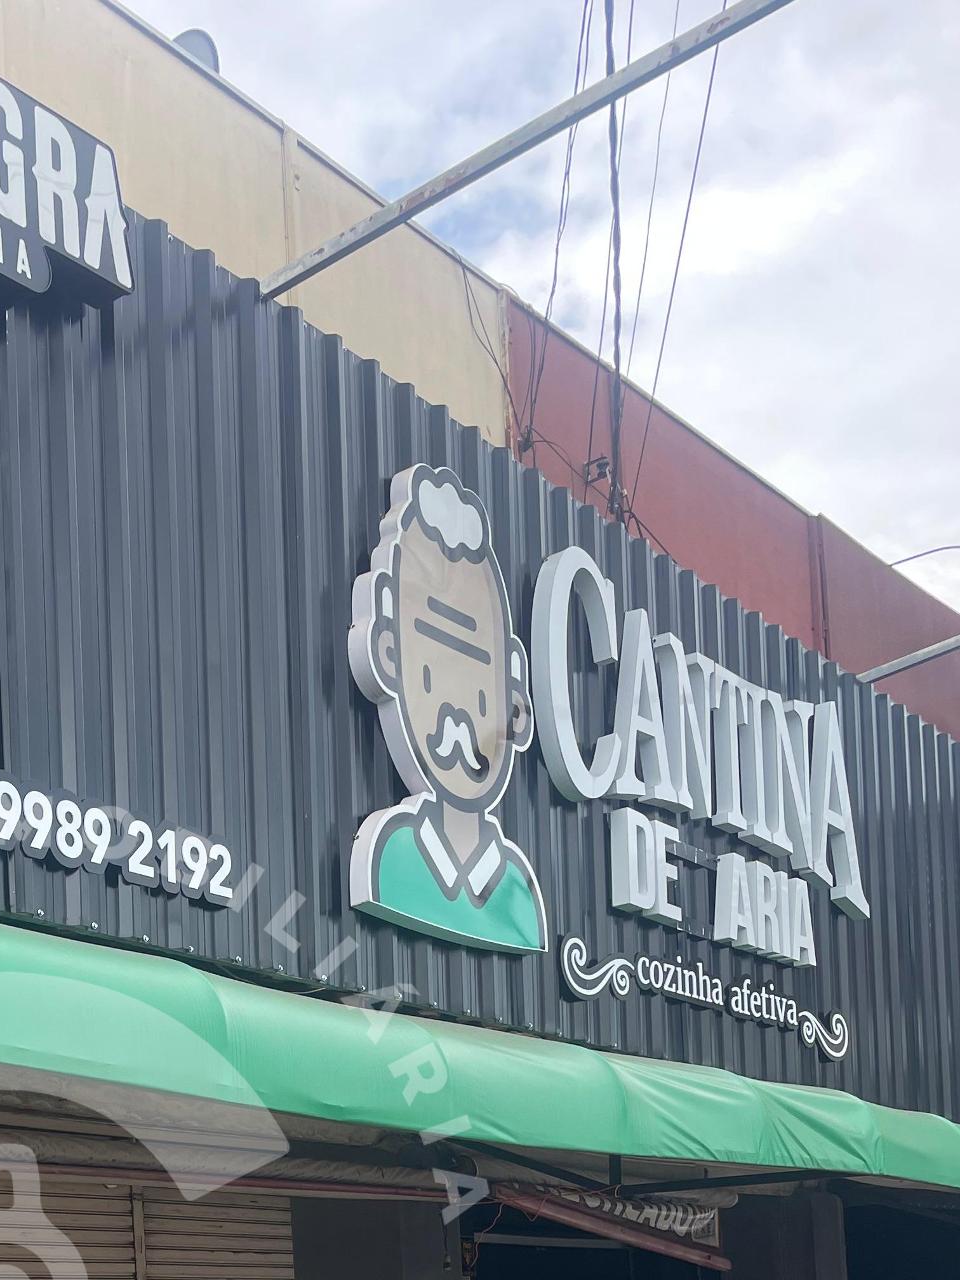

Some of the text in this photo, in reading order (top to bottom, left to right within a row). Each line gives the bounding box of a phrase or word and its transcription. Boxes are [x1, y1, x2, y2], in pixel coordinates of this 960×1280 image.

[531, 546, 870, 919] CANTINA
[127, 820, 233, 899] 2192
[611, 807, 682, 927] DE
[638, 956, 799, 1026] cozinha afetiva
